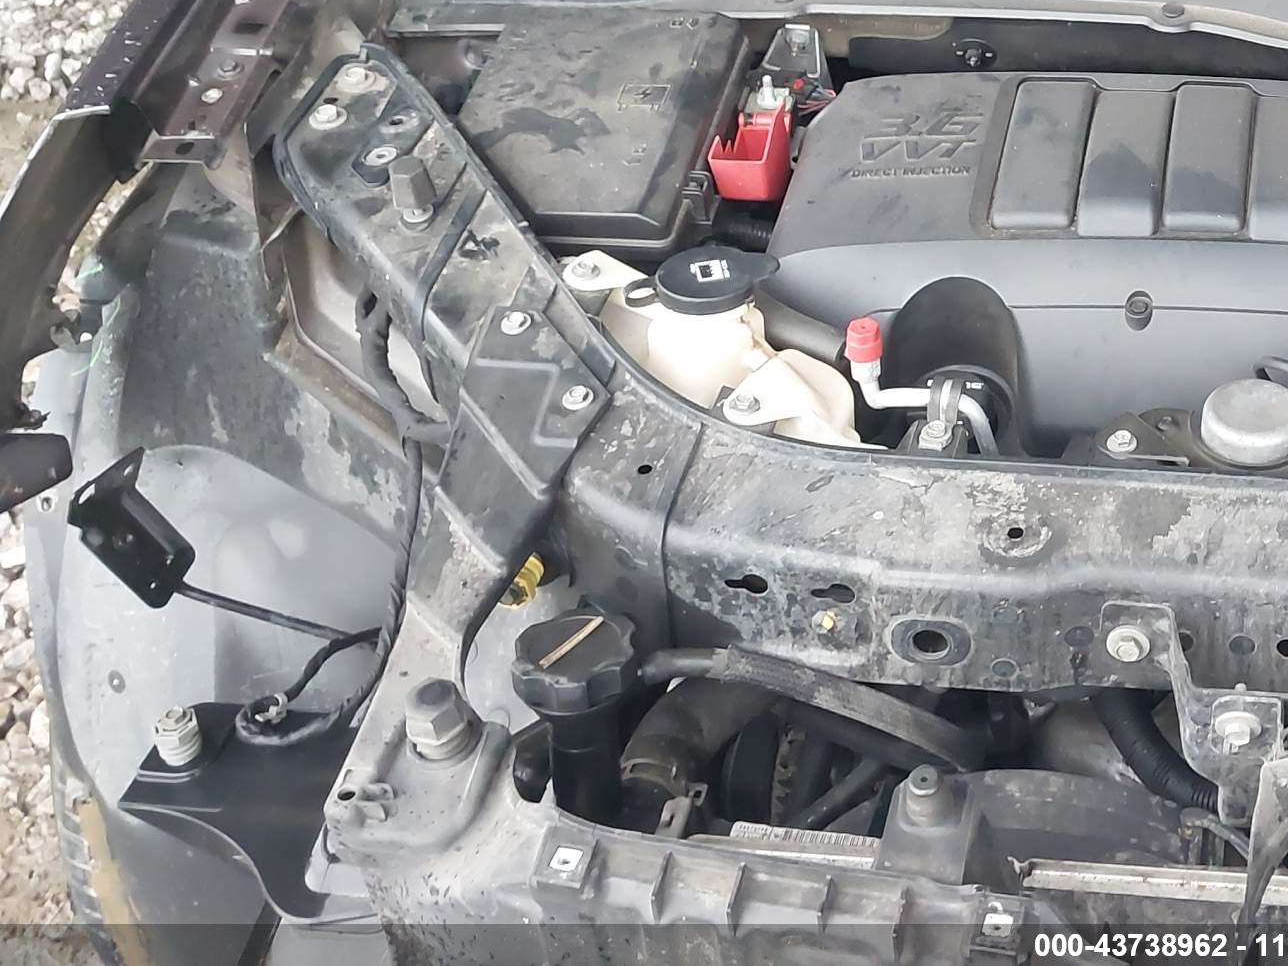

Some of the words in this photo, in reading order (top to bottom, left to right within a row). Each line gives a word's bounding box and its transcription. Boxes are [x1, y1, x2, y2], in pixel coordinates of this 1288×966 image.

[866, 112, 984, 138] 3.6
[860, 138, 977, 162] VVT
[850, 168, 898, 179] DIRECT
[902, 165, 971, 178] INJECTION
